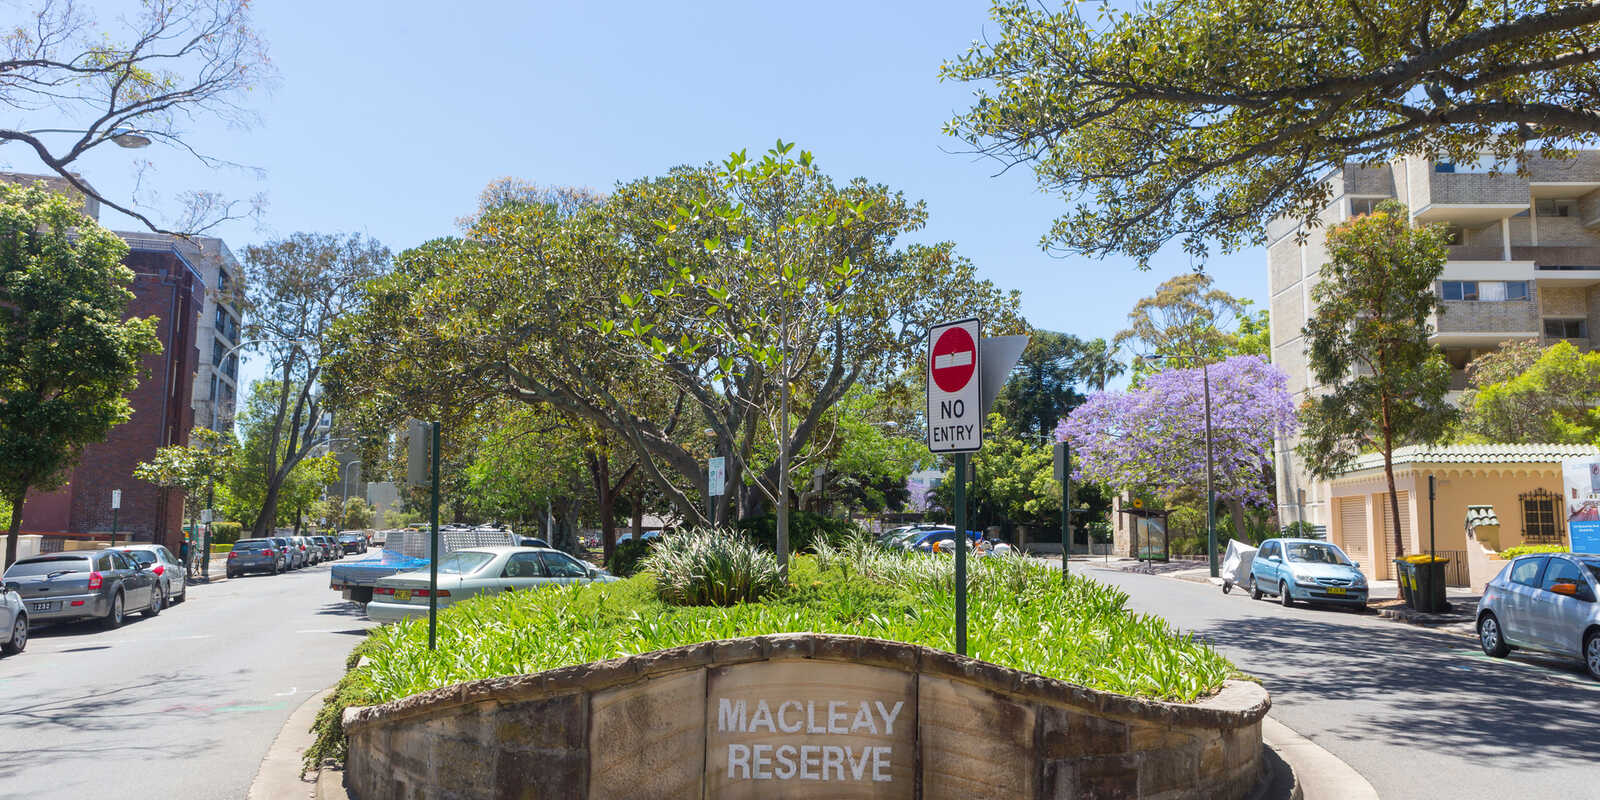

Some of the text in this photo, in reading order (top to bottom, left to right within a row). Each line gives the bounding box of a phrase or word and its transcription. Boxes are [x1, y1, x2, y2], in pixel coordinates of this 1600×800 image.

[941, 399, 965, 420] NO
[933, 424, 974, 442] ENTRY
[717, 697, 905, 735] MACLEAY
[727, 743, 893, 782] RESERVE
